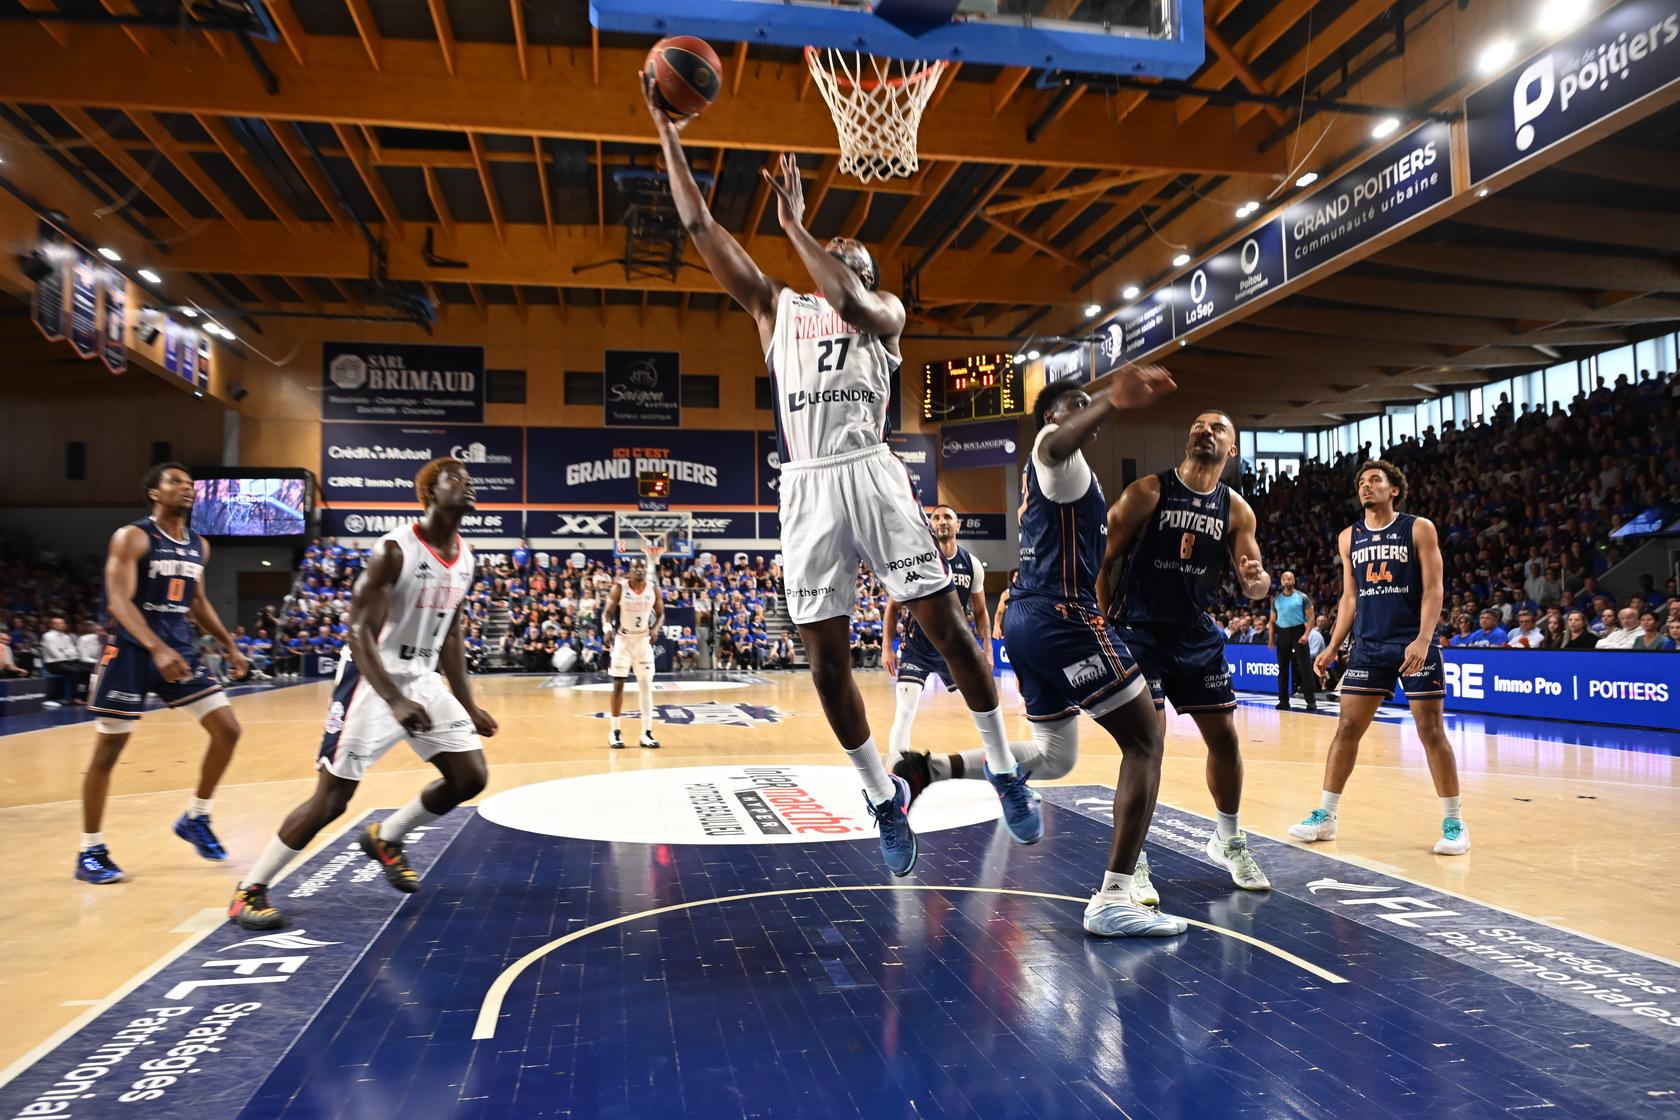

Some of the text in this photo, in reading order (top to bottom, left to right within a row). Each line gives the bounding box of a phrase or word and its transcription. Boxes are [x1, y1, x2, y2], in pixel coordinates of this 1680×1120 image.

[1294, 140, 1437, 241] GRAND POITIERS
[1294, 171, 1439, 260] Communauté urbaine
[1240, 273, 1262, 291] Poitou
[1186, 301, 1214, 325] La Sep
[368, 355, 406, 369] SARL
[817, 337, 850, 373] 27
[368, 370, 476, 393] BRIMAUD
[807, 388, 876, 405] LEGENDRE
[612, 447, 630, 458] ICI
[396, 478, 414, 489] Pro
[566, 458, 718, 488] GRAND POITIERS
[1159, 510, 1224, 541] POITIERS
[1180, 532, 1196, 560] 8
[1352, 544, 1409, 569] POITIERS
[1366, 561, 1393, 584] 44
[167, 578, 186, 602] 0
[1246, 662, 1280, 677] POITIERS
[1494, 675, 1533, 694] Immo
[1535, 677, 1562, 696] Pro
[1589, 680, 1669, 703] POITIERS
[742, 795, 780, 829] HYPER
[1477, 927, 1678, 995] Stratégies
[1425, 930, 1680, 1027] Patrimoniales
[10, 1005, 194, 1120] Patrimonial
[117, 1001, 263, 1103] Stratégies
